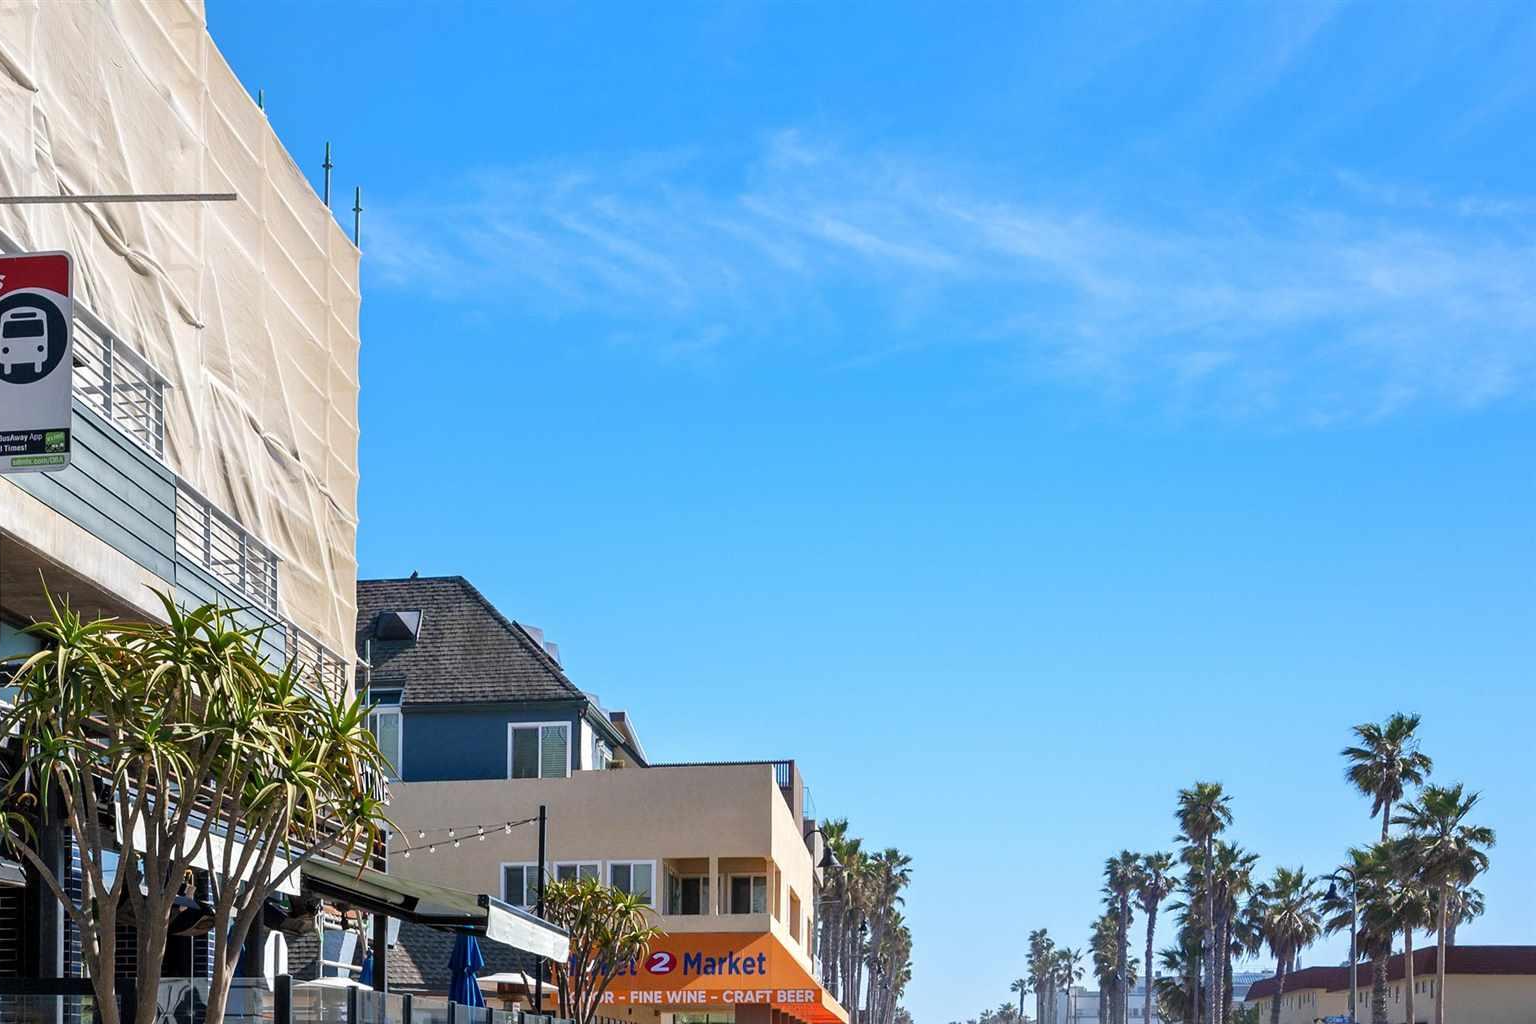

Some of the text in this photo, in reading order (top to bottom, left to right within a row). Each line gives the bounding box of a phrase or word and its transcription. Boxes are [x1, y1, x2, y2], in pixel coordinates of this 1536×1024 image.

[29, 433, 43, 442] App
[4, 443, 27, 452] Times!
[650, 953, 670, 972] 2
[683, 951, 767, 976] Market
[630, 990, 662, 1004] FINE
[665, 990, 706, 1003] WINE
[723, 990, 773, 1003] CRAFT
[777, 989, 815, 1003] BEER
